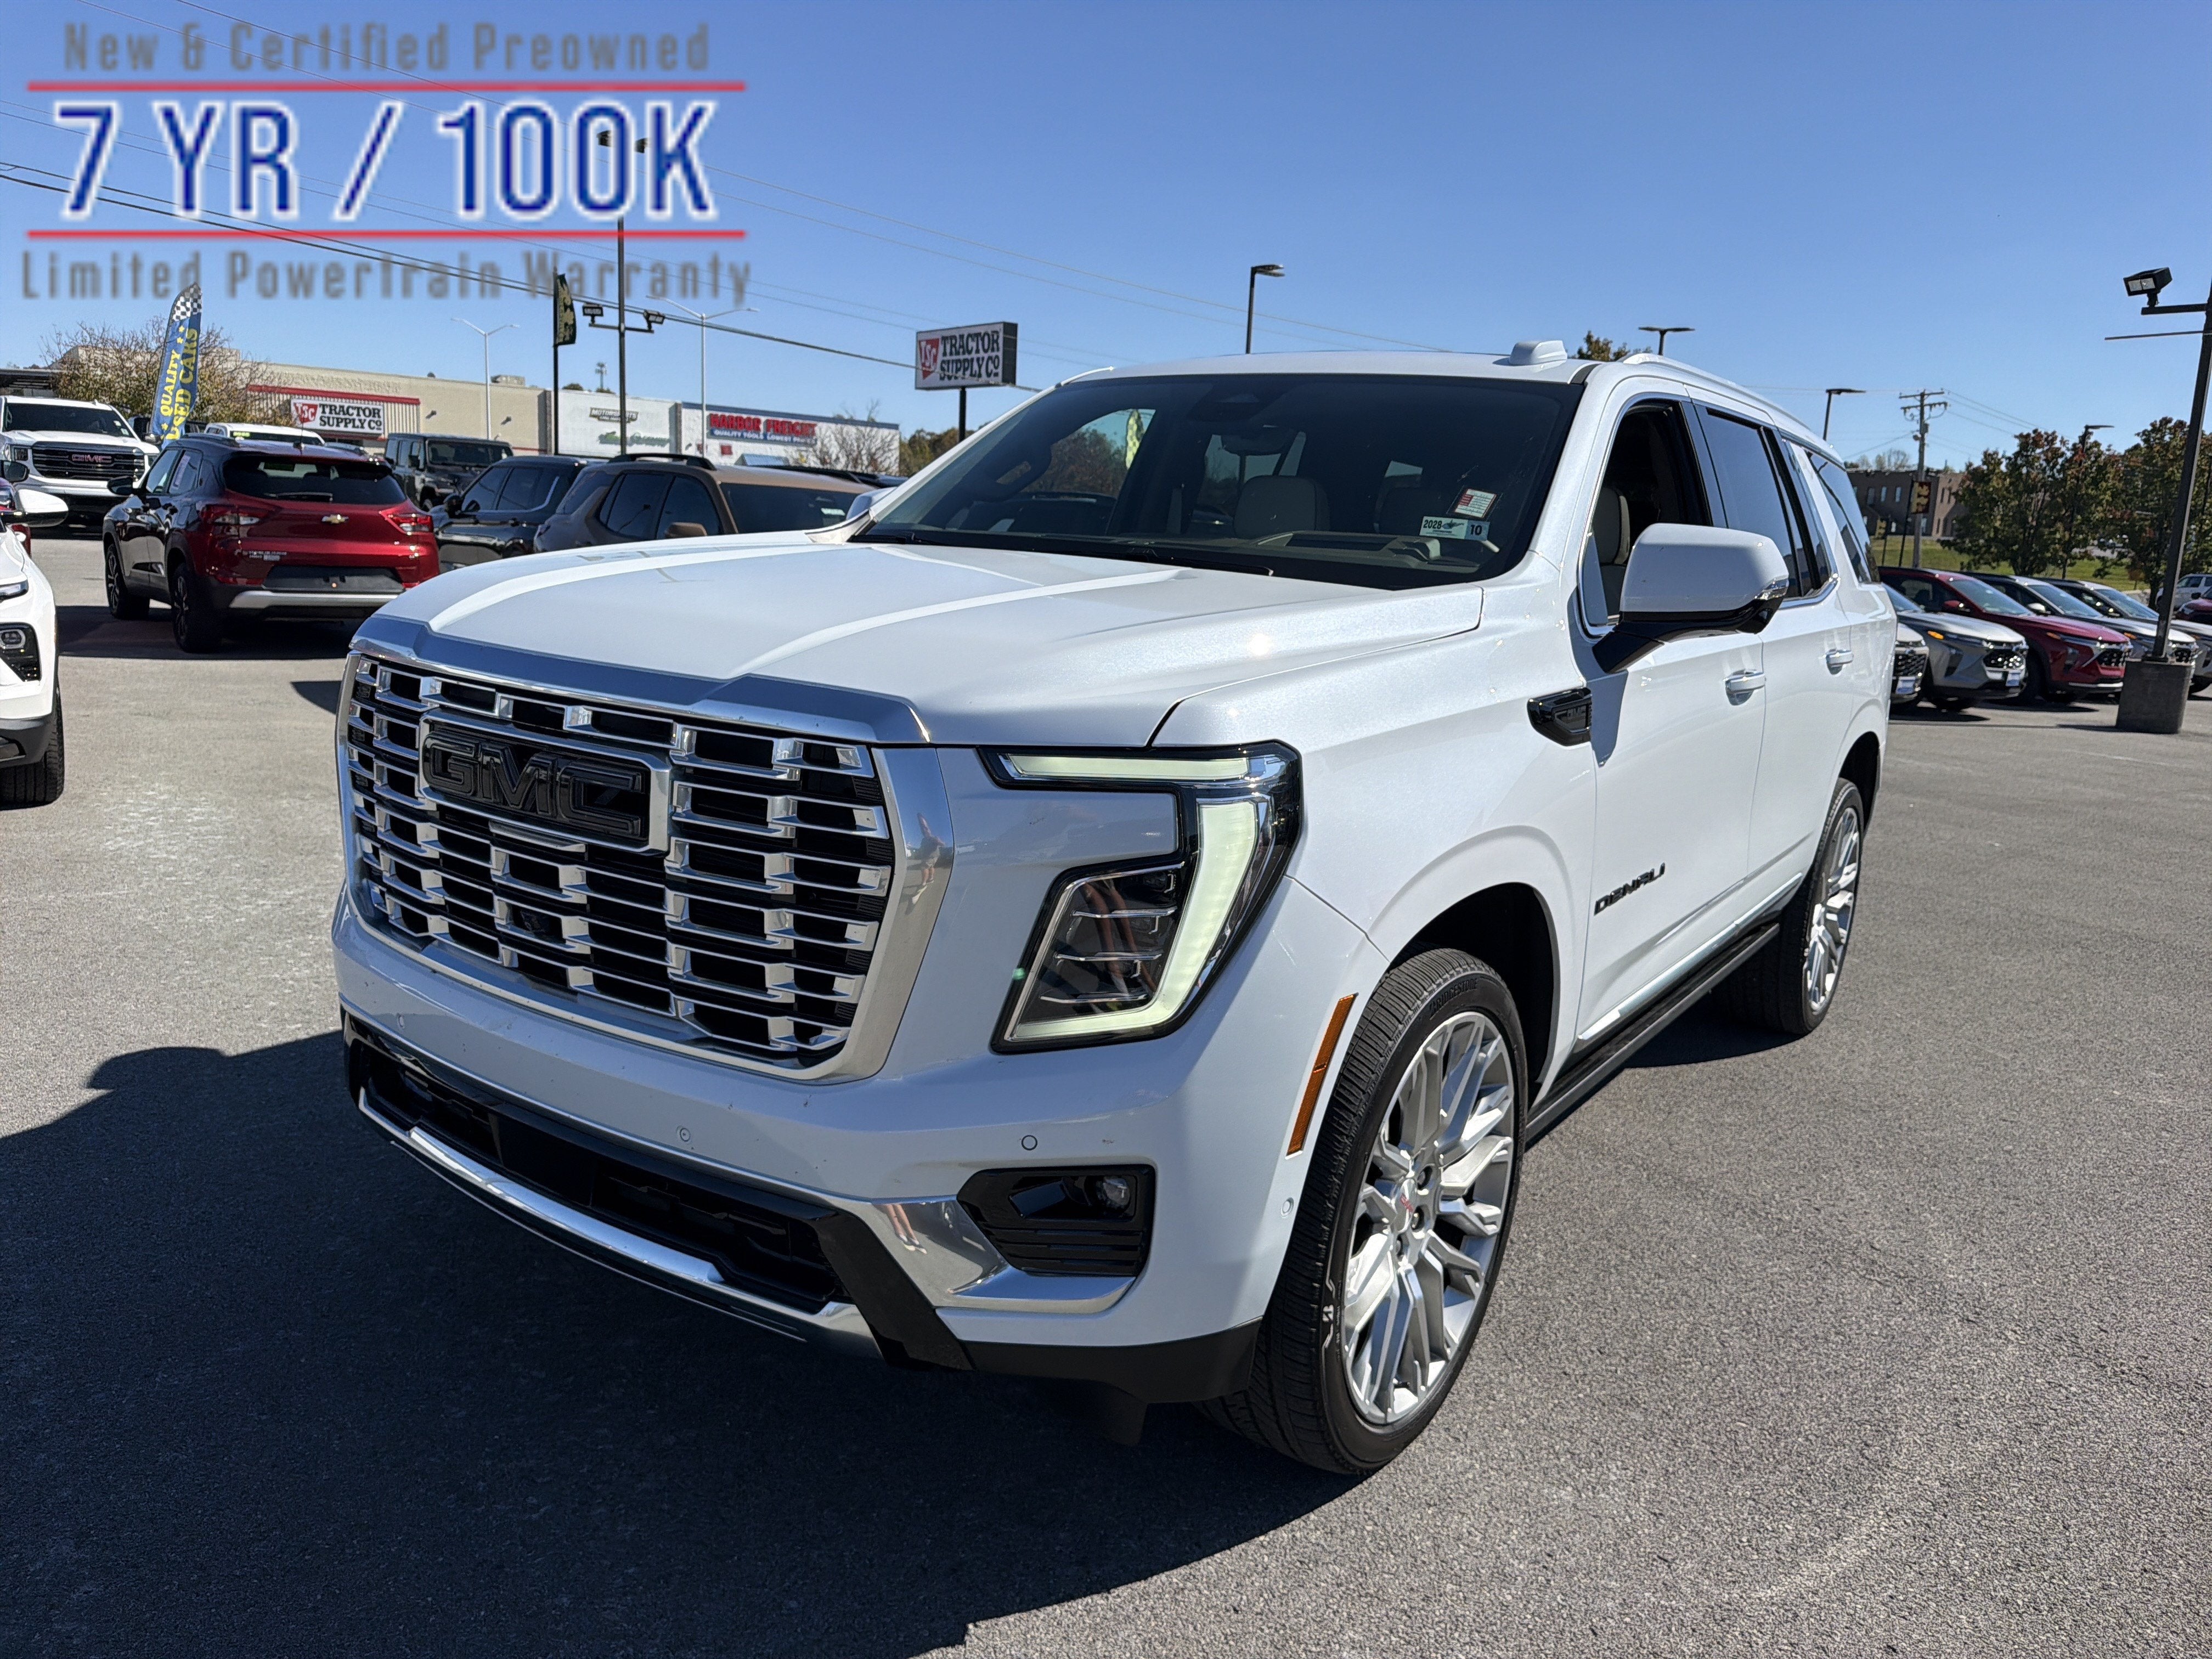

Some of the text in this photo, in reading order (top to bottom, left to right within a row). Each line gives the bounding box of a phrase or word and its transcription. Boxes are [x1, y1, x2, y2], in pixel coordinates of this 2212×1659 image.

[941, 330, 1000, 357] TRACTOR
[179, 328, 198, 384] CARS
[939, 357, 985, 381] SUPPLY
[160, 349, 181, 417] QUALITY
[319, 403, 382, 419] TRACTOR
[319, 416, 366, 430] SUPPLY
[709, 413, 817, 437] HARBOR FREIGHT
[1423, 520, 1442, 529] 2028
[1470, 524, 1482, 535] 10
[423, 731, 648, 840] GMC
[1594, 862, 1665, 916] DENALI
